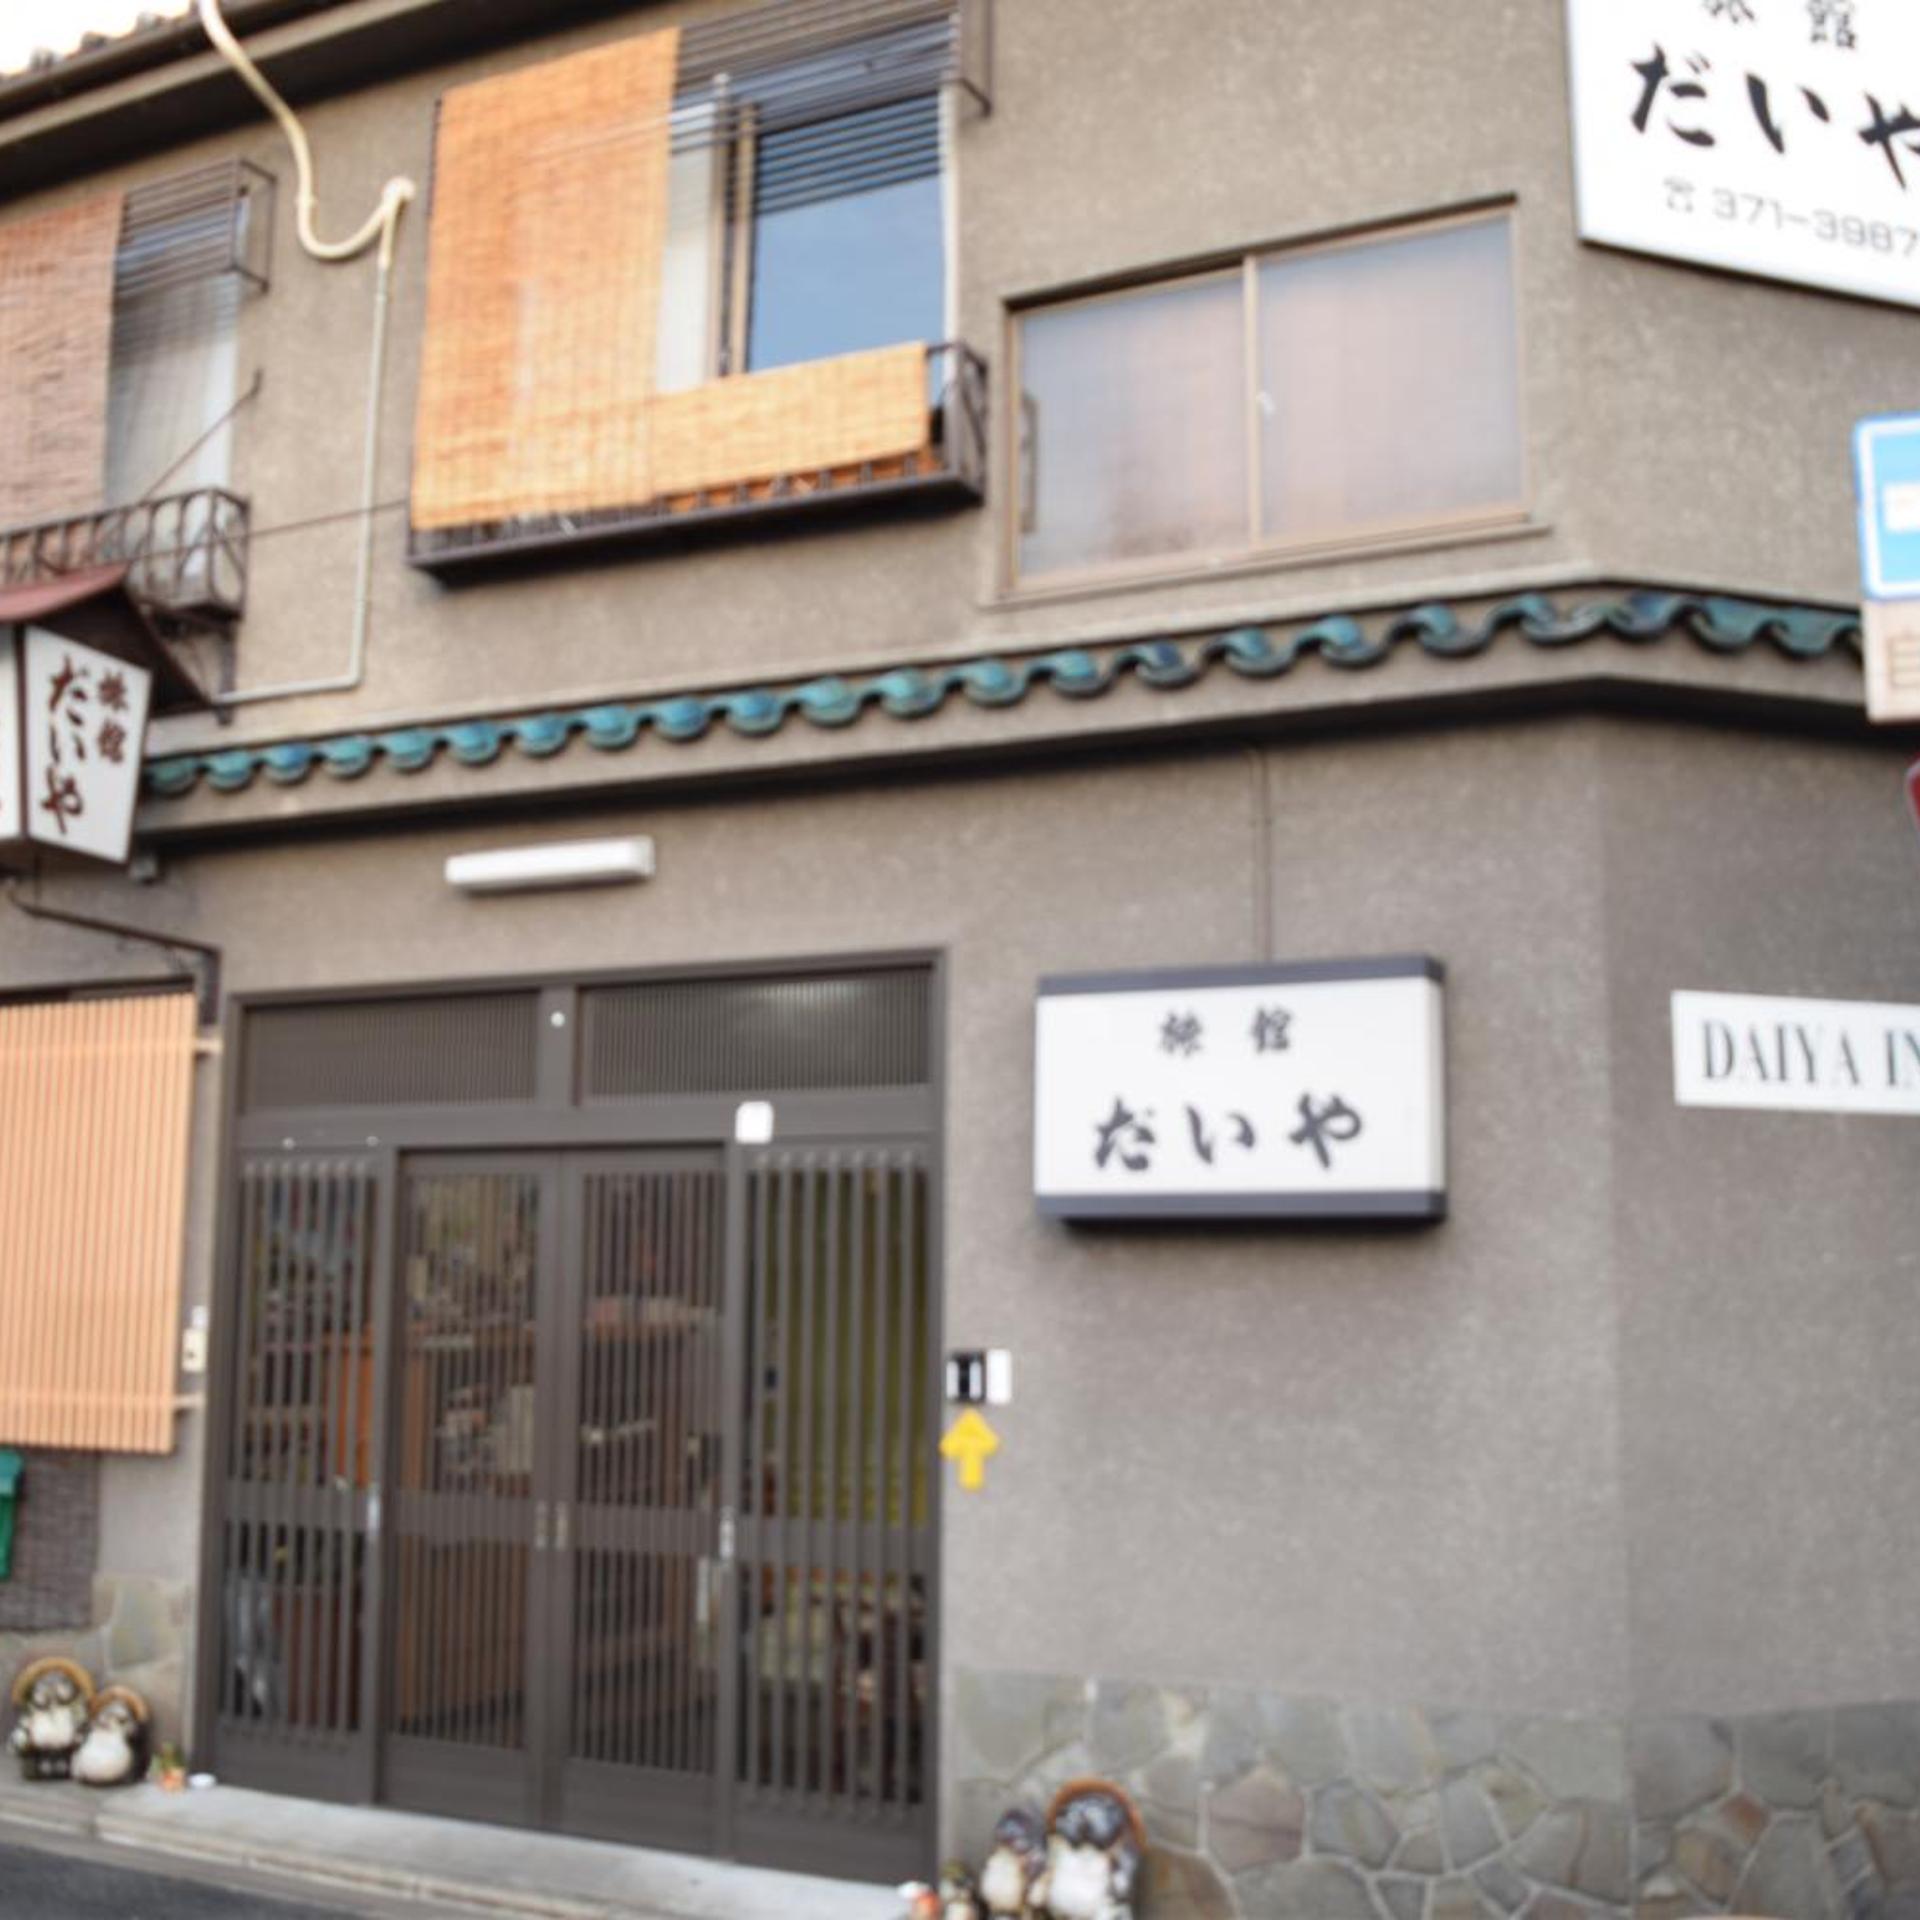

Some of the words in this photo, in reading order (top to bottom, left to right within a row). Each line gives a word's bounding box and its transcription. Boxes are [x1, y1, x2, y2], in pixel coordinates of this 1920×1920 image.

[1630, 42, 1920, 191] だいや
[41, 654, 88, 835] だいや
[1702, 1018, 1860, 1086] DAIYA
[1094, 1093, 1363, 1171] だいや
